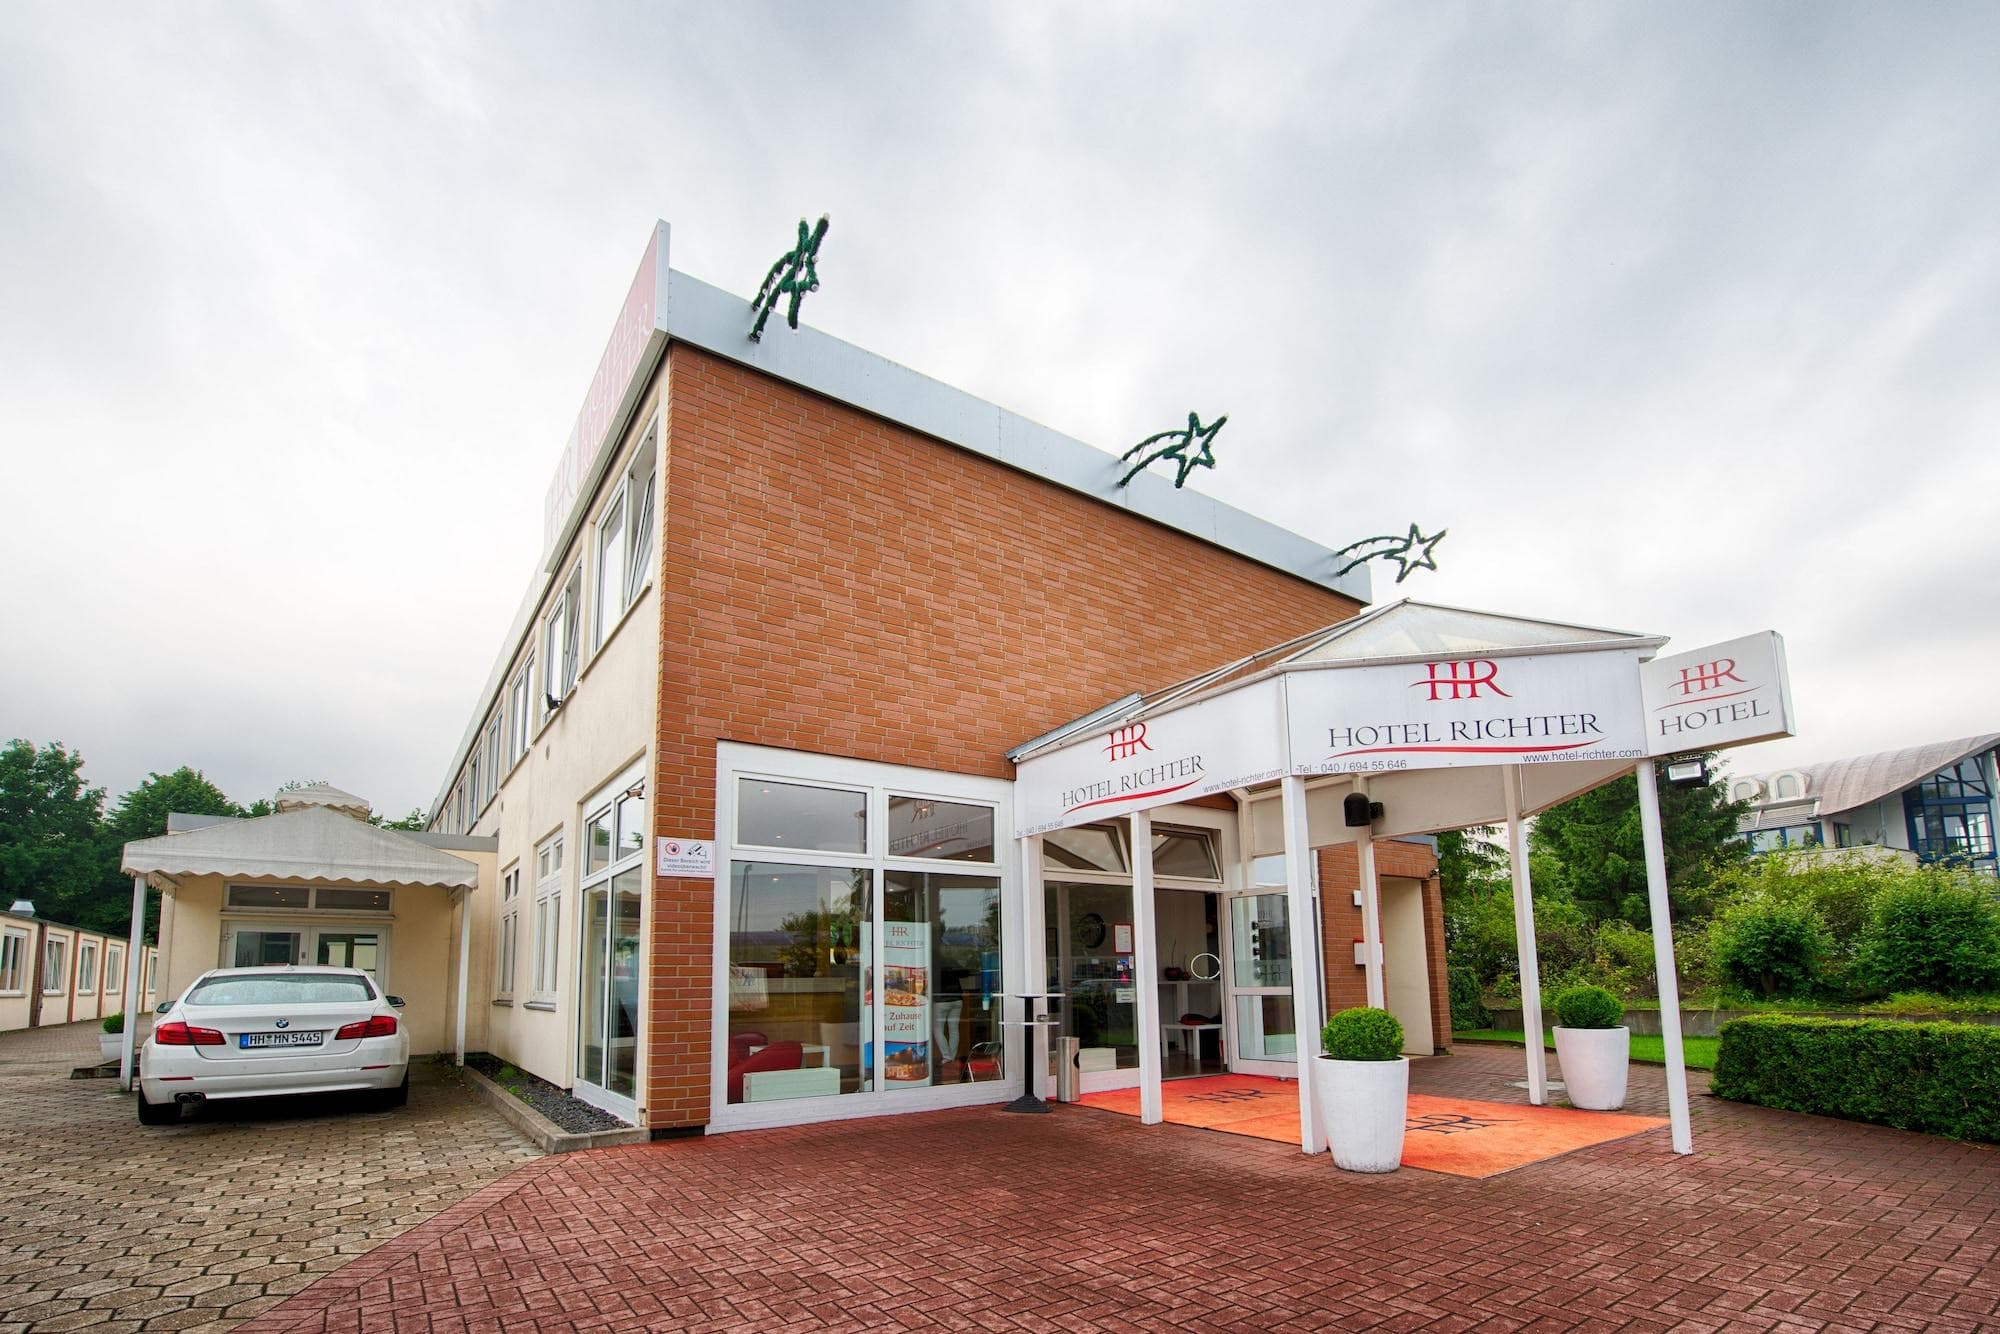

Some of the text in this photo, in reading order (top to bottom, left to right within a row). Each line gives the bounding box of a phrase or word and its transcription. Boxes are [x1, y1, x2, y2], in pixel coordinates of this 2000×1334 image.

[1660, 699, 1770, 736] HOTEL
[1329, 713, 1604, 747] HOTEL RICHTER
[1522, 748, 1642, 763] www.hotel-richter.com
[1320, 763, 1340, 773] 040
[1349, 762, 1368, 772] 694
[1371, 760, 1385, 770] 55
[1387, 759, 1407, 769] 646
[1062, 755, 1205, 807] HOTEL RICHTER
[1202, 768, 1283, 793] www.hotel-richter.com
[889, 1012, 922, 1021] Zuhause
[899, 1022, 915, 1031] Zeit
[250, 1032, 320, 1045] HH MN 5445
